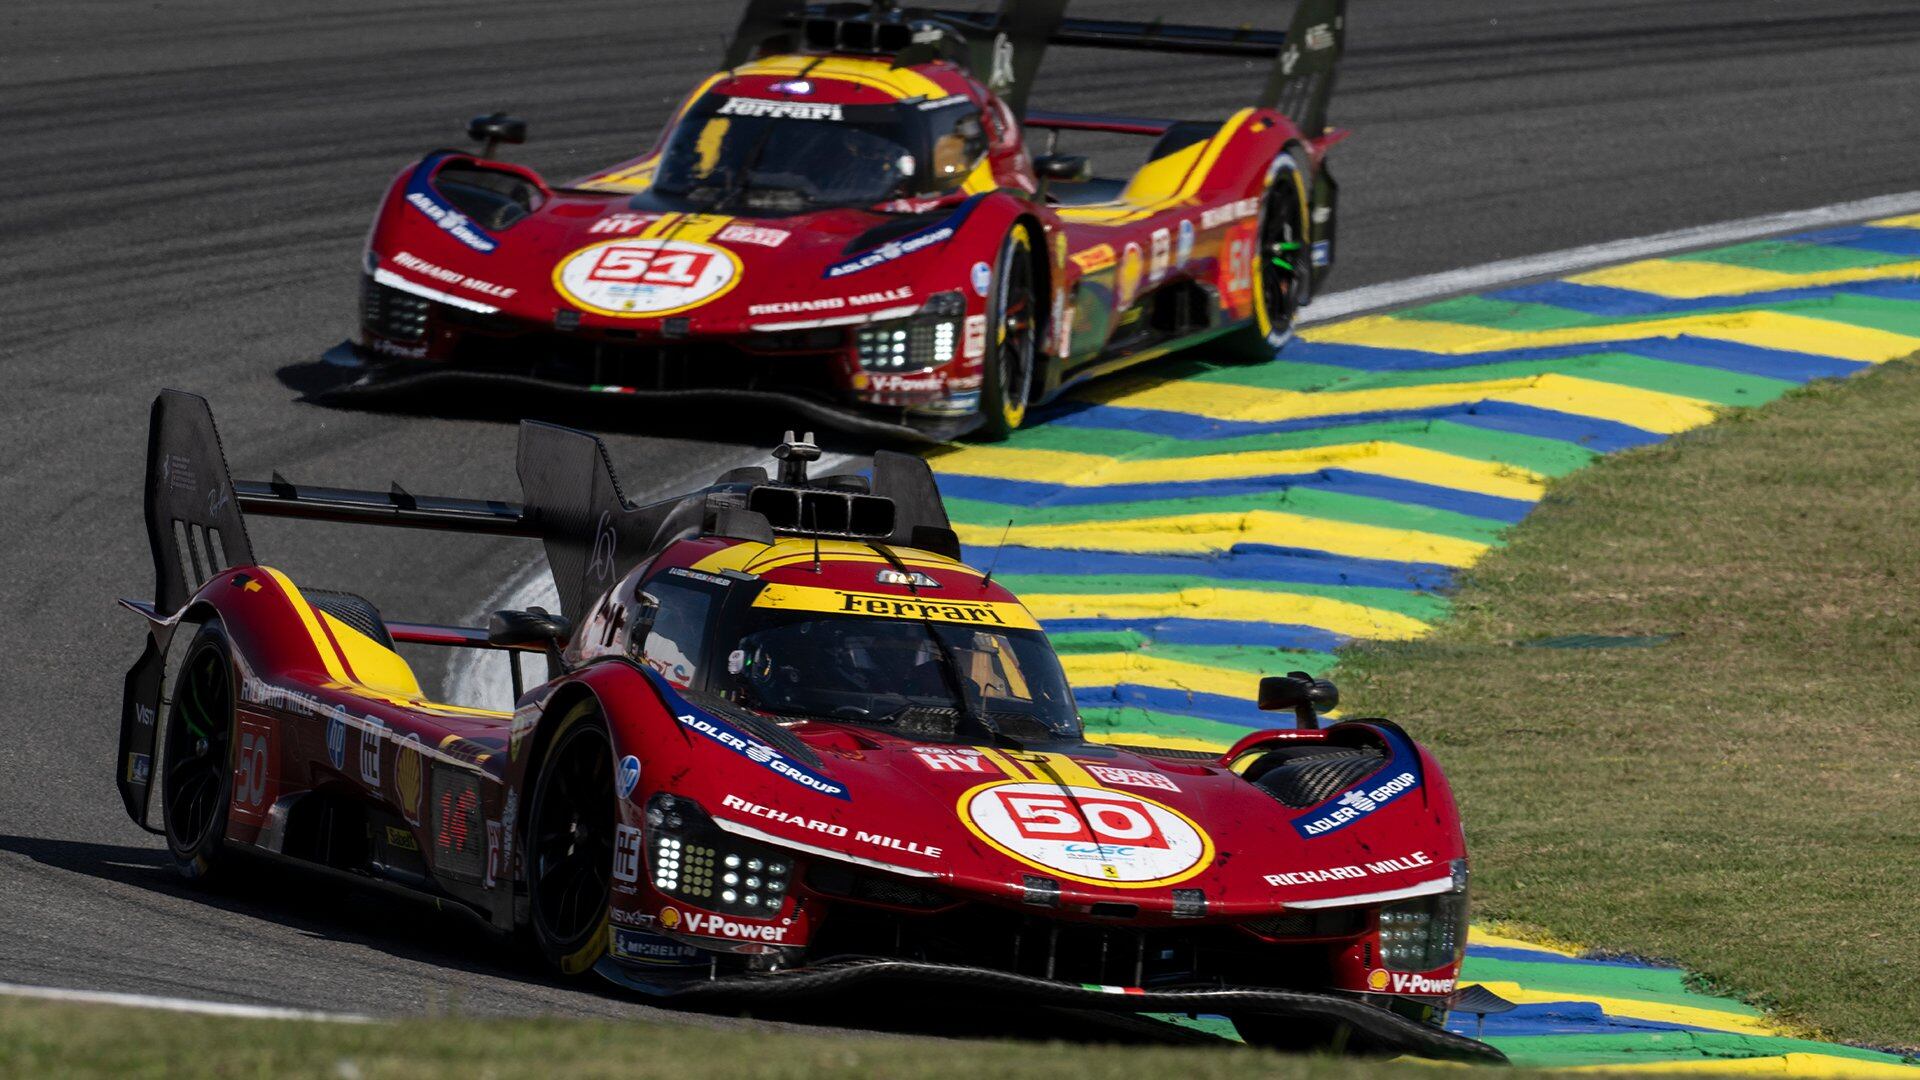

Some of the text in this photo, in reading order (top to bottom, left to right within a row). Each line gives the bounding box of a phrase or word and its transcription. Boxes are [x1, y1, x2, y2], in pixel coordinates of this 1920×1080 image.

[717, 97, 844, 121] Ferrari
[392, 251, 518, 299] RICHARD MILLE
[596, 249, 696, 284] 51
[749, 286, 913, 316] RICHARD MILLE
[839, 591, 1006, 625] Ferrari
[237, 733, 268, 806] 50
[677, 714, 842, 795] ADLER GROUP
[918, 753, 984, 772] HY
[1007, 797, 1152, 840] 50
[1303, 772, 1416, 835] ADLER GROUP
[721, 794, 943, 858] RICHARD MILLE
[1263, 851, 1434, 887] RICHARD MILLE
[684, 912, 788, 942] V-Power
[627, 941, 697, 957] MICHELIN
[1392, 973, 1456, 993] V-Power
